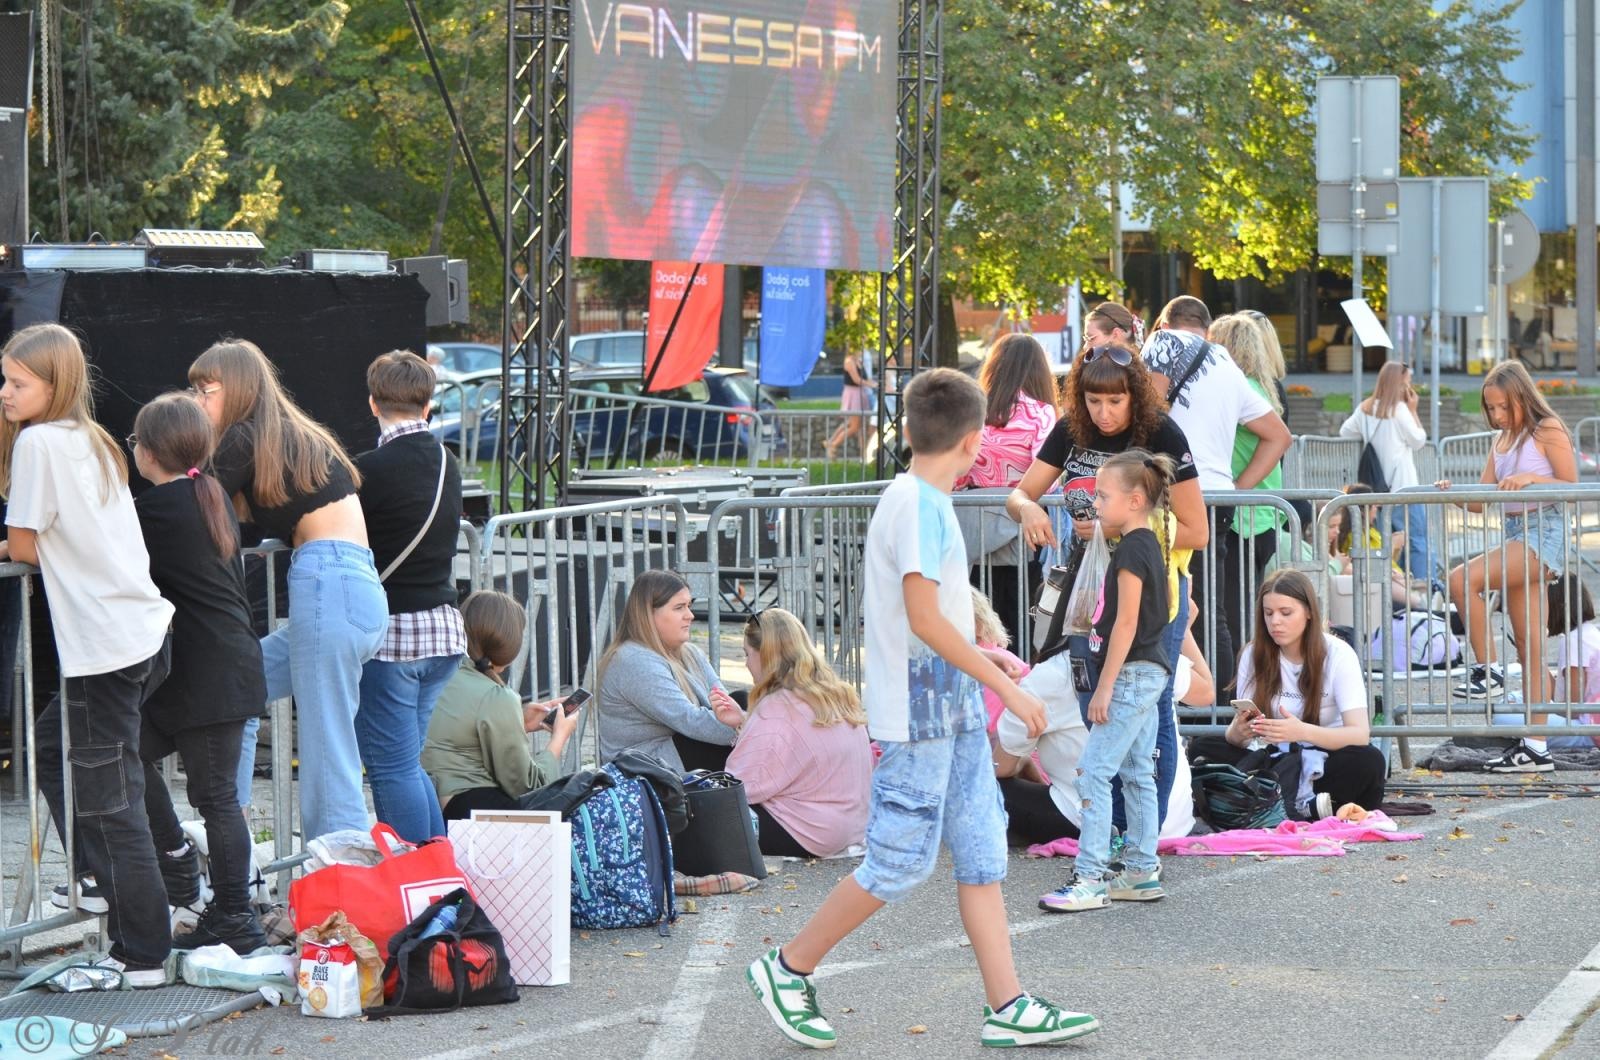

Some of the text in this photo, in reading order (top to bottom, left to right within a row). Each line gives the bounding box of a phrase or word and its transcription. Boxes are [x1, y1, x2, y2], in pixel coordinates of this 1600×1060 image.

[582, 0, 881, 73] VANESSA FM
[655, 270, 708, 288] Dodaj oś
[766, 272, 790, 289] Dodaj
[313, 965, 329, 974] BAKE
